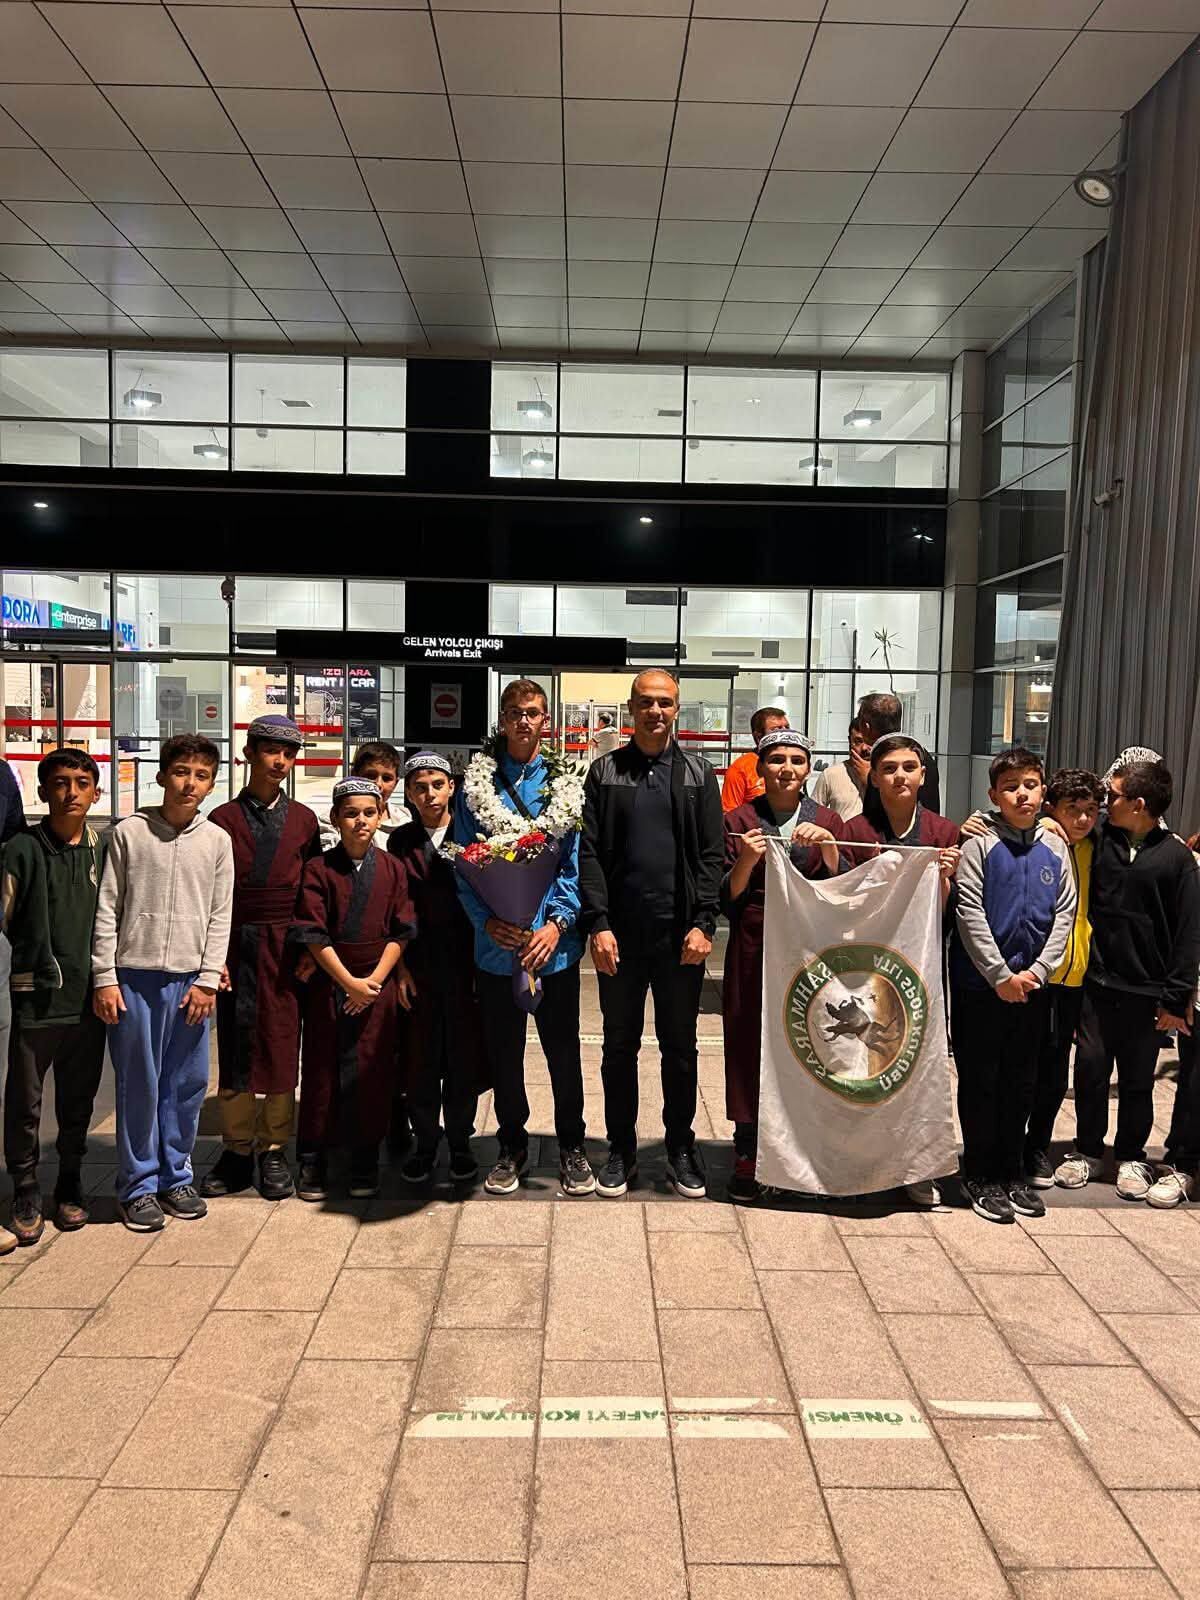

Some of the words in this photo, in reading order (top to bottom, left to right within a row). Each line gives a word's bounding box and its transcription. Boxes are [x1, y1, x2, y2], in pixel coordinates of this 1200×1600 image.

[54, 610, 97, 628] enterprise
[402, 636, 437, 647] GELEN
[438, 637, 473, 648] YOLCU
[474, 638, 504, 650] ÇIKIŞI
[424, 648, 461, 657] Arrivals
[463, 649, 482, 658] Exit
[305, 676, 338, 687] RENT
[350, 677, 376, 688] CAR
